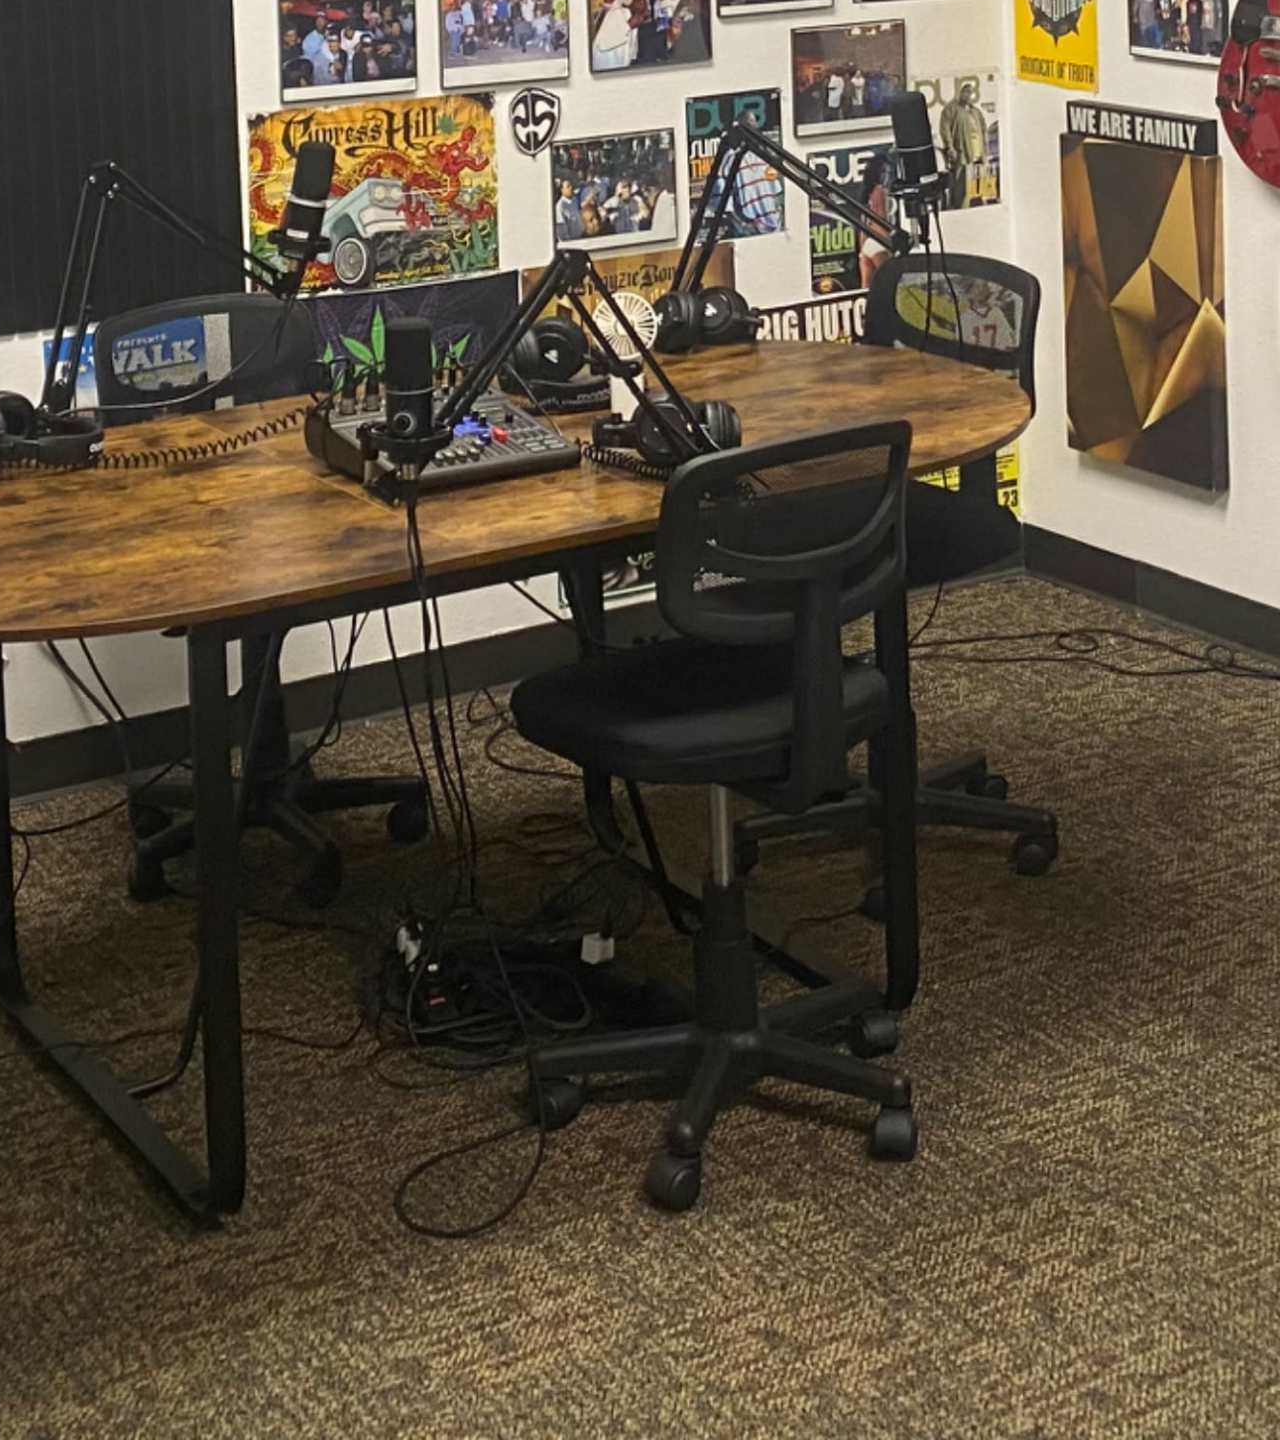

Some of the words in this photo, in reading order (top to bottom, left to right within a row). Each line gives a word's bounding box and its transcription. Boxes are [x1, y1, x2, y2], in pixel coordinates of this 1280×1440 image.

[1070, 106, 1097, 135] WE
[1099, 111, 1133, 140] ARE
[1134, 115, 1198, 151] FAMILY
